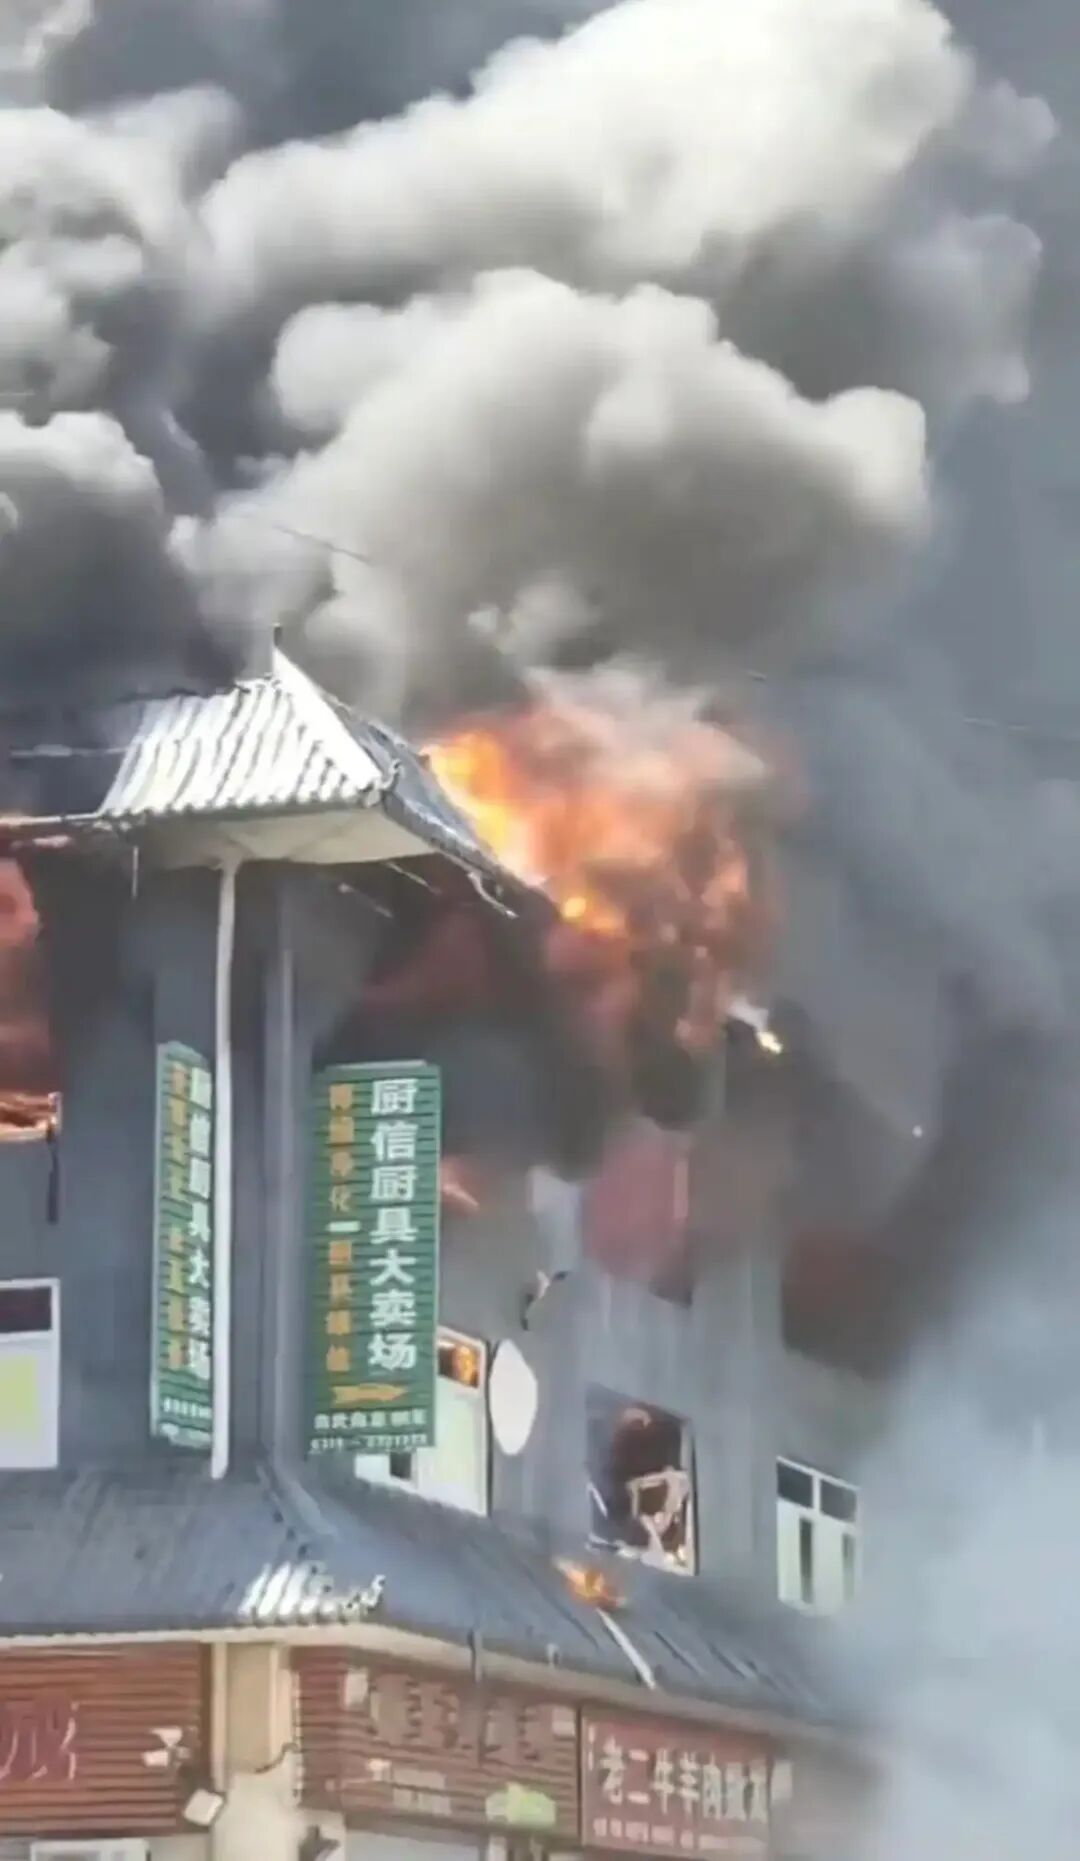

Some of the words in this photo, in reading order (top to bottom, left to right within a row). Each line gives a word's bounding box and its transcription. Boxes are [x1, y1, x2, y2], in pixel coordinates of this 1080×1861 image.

[368, 1078, 419, 1370] 厨信厨具大卖场
